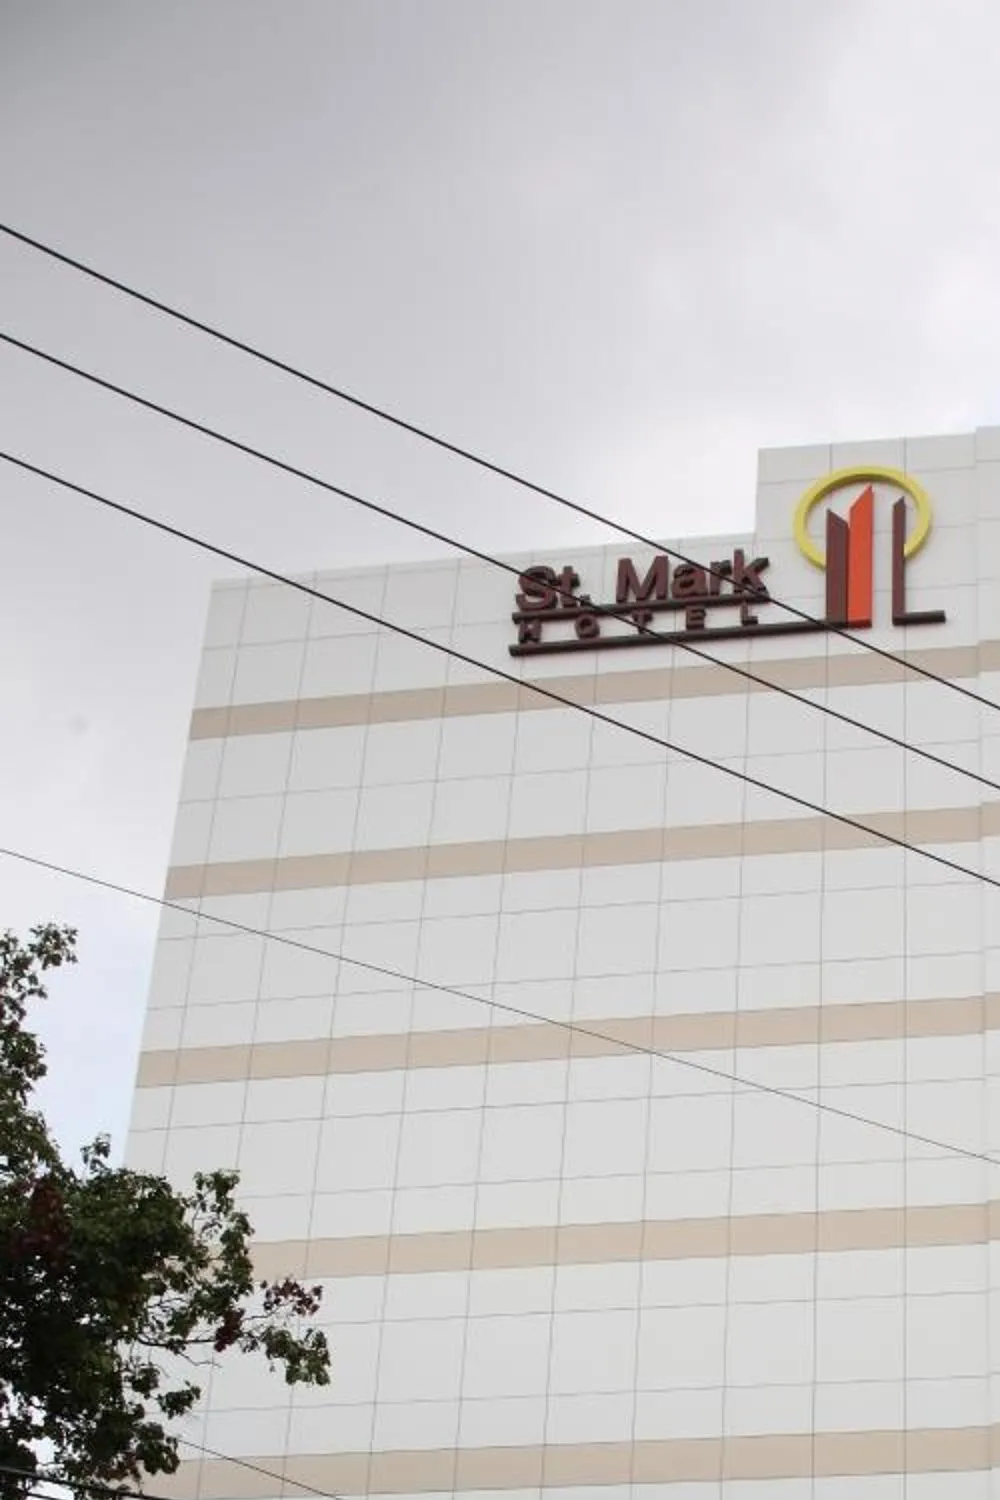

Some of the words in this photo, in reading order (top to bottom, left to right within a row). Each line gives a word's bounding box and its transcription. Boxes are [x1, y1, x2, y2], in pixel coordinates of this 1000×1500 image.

[515, 565, 590, 611] St.
[616, 548, 769, 603] Mark
[518, 601, 759, 644] HOTEL
